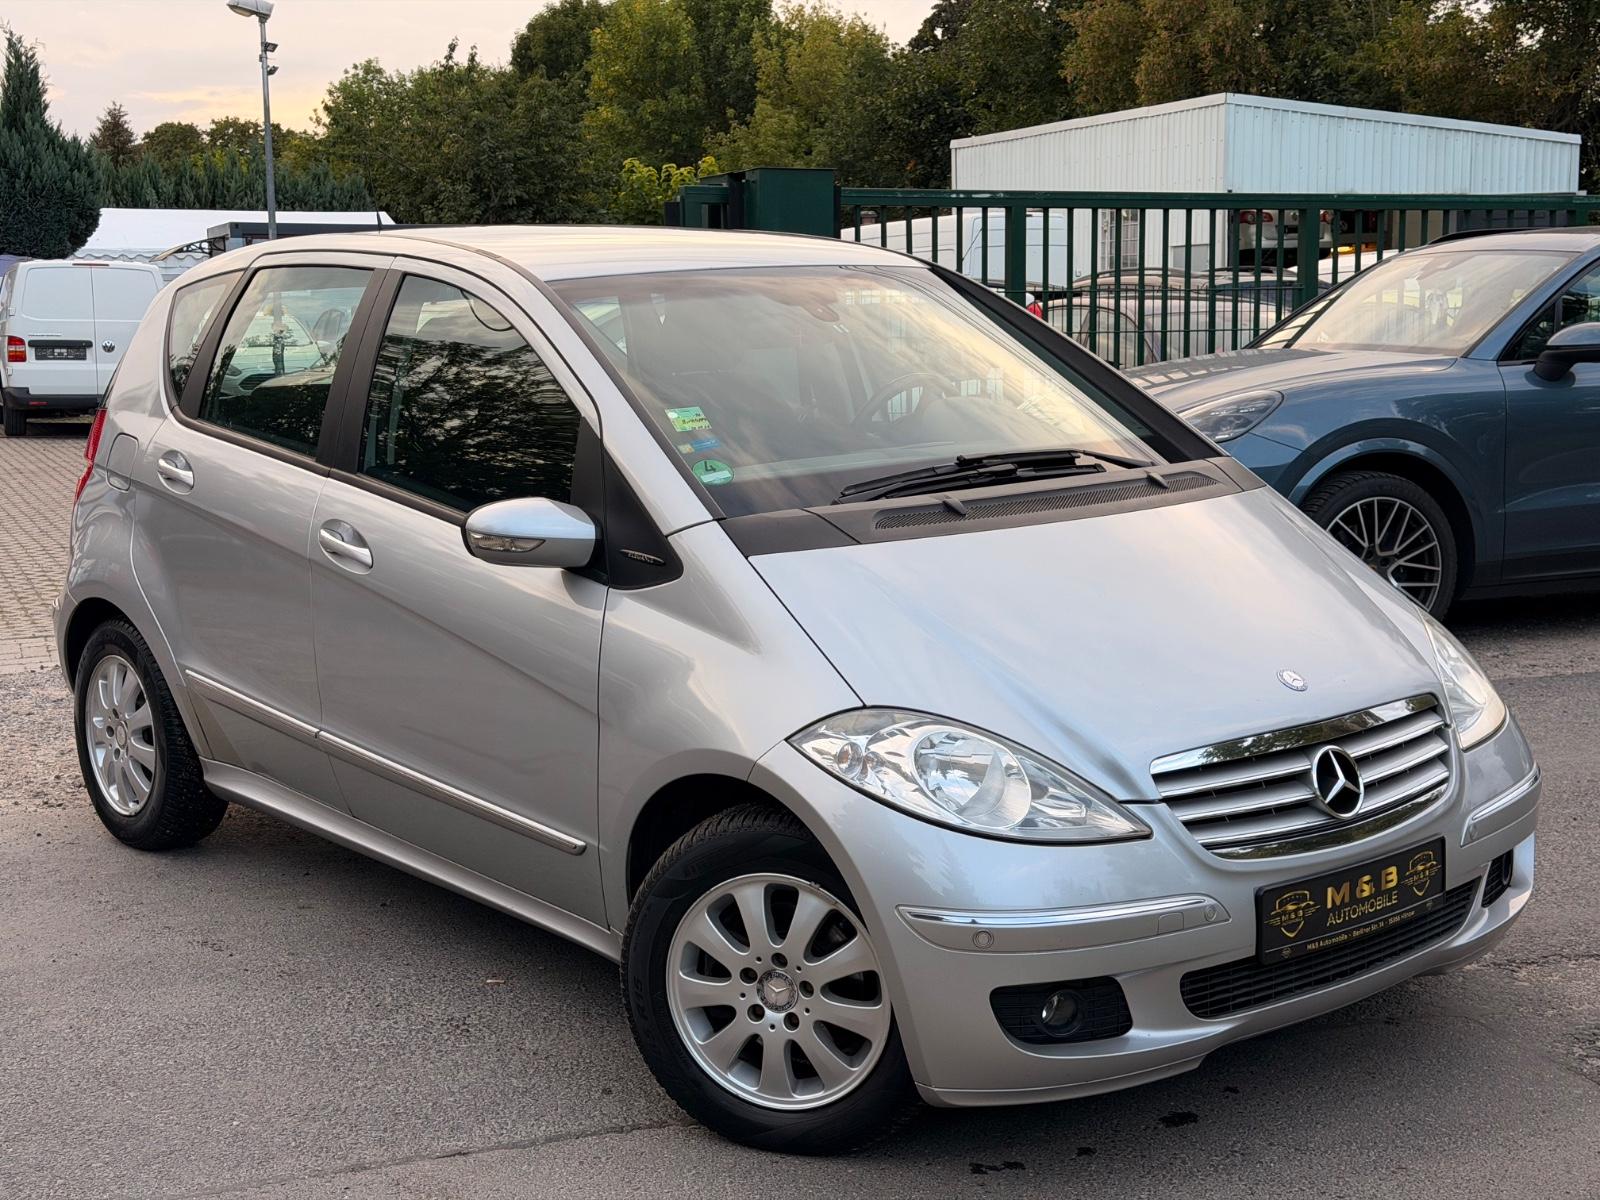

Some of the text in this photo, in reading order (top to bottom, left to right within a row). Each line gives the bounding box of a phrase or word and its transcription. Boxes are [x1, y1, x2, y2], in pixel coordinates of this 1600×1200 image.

[704, 460, 716, 472] 4
[1326, 865, 1398, 909] M & B
[1326, 890, 1399, 926] AUTOMOBILE
[1319, 933, 1348, 947] Automobile
[1352, 926, 1371, 938] Berliner
